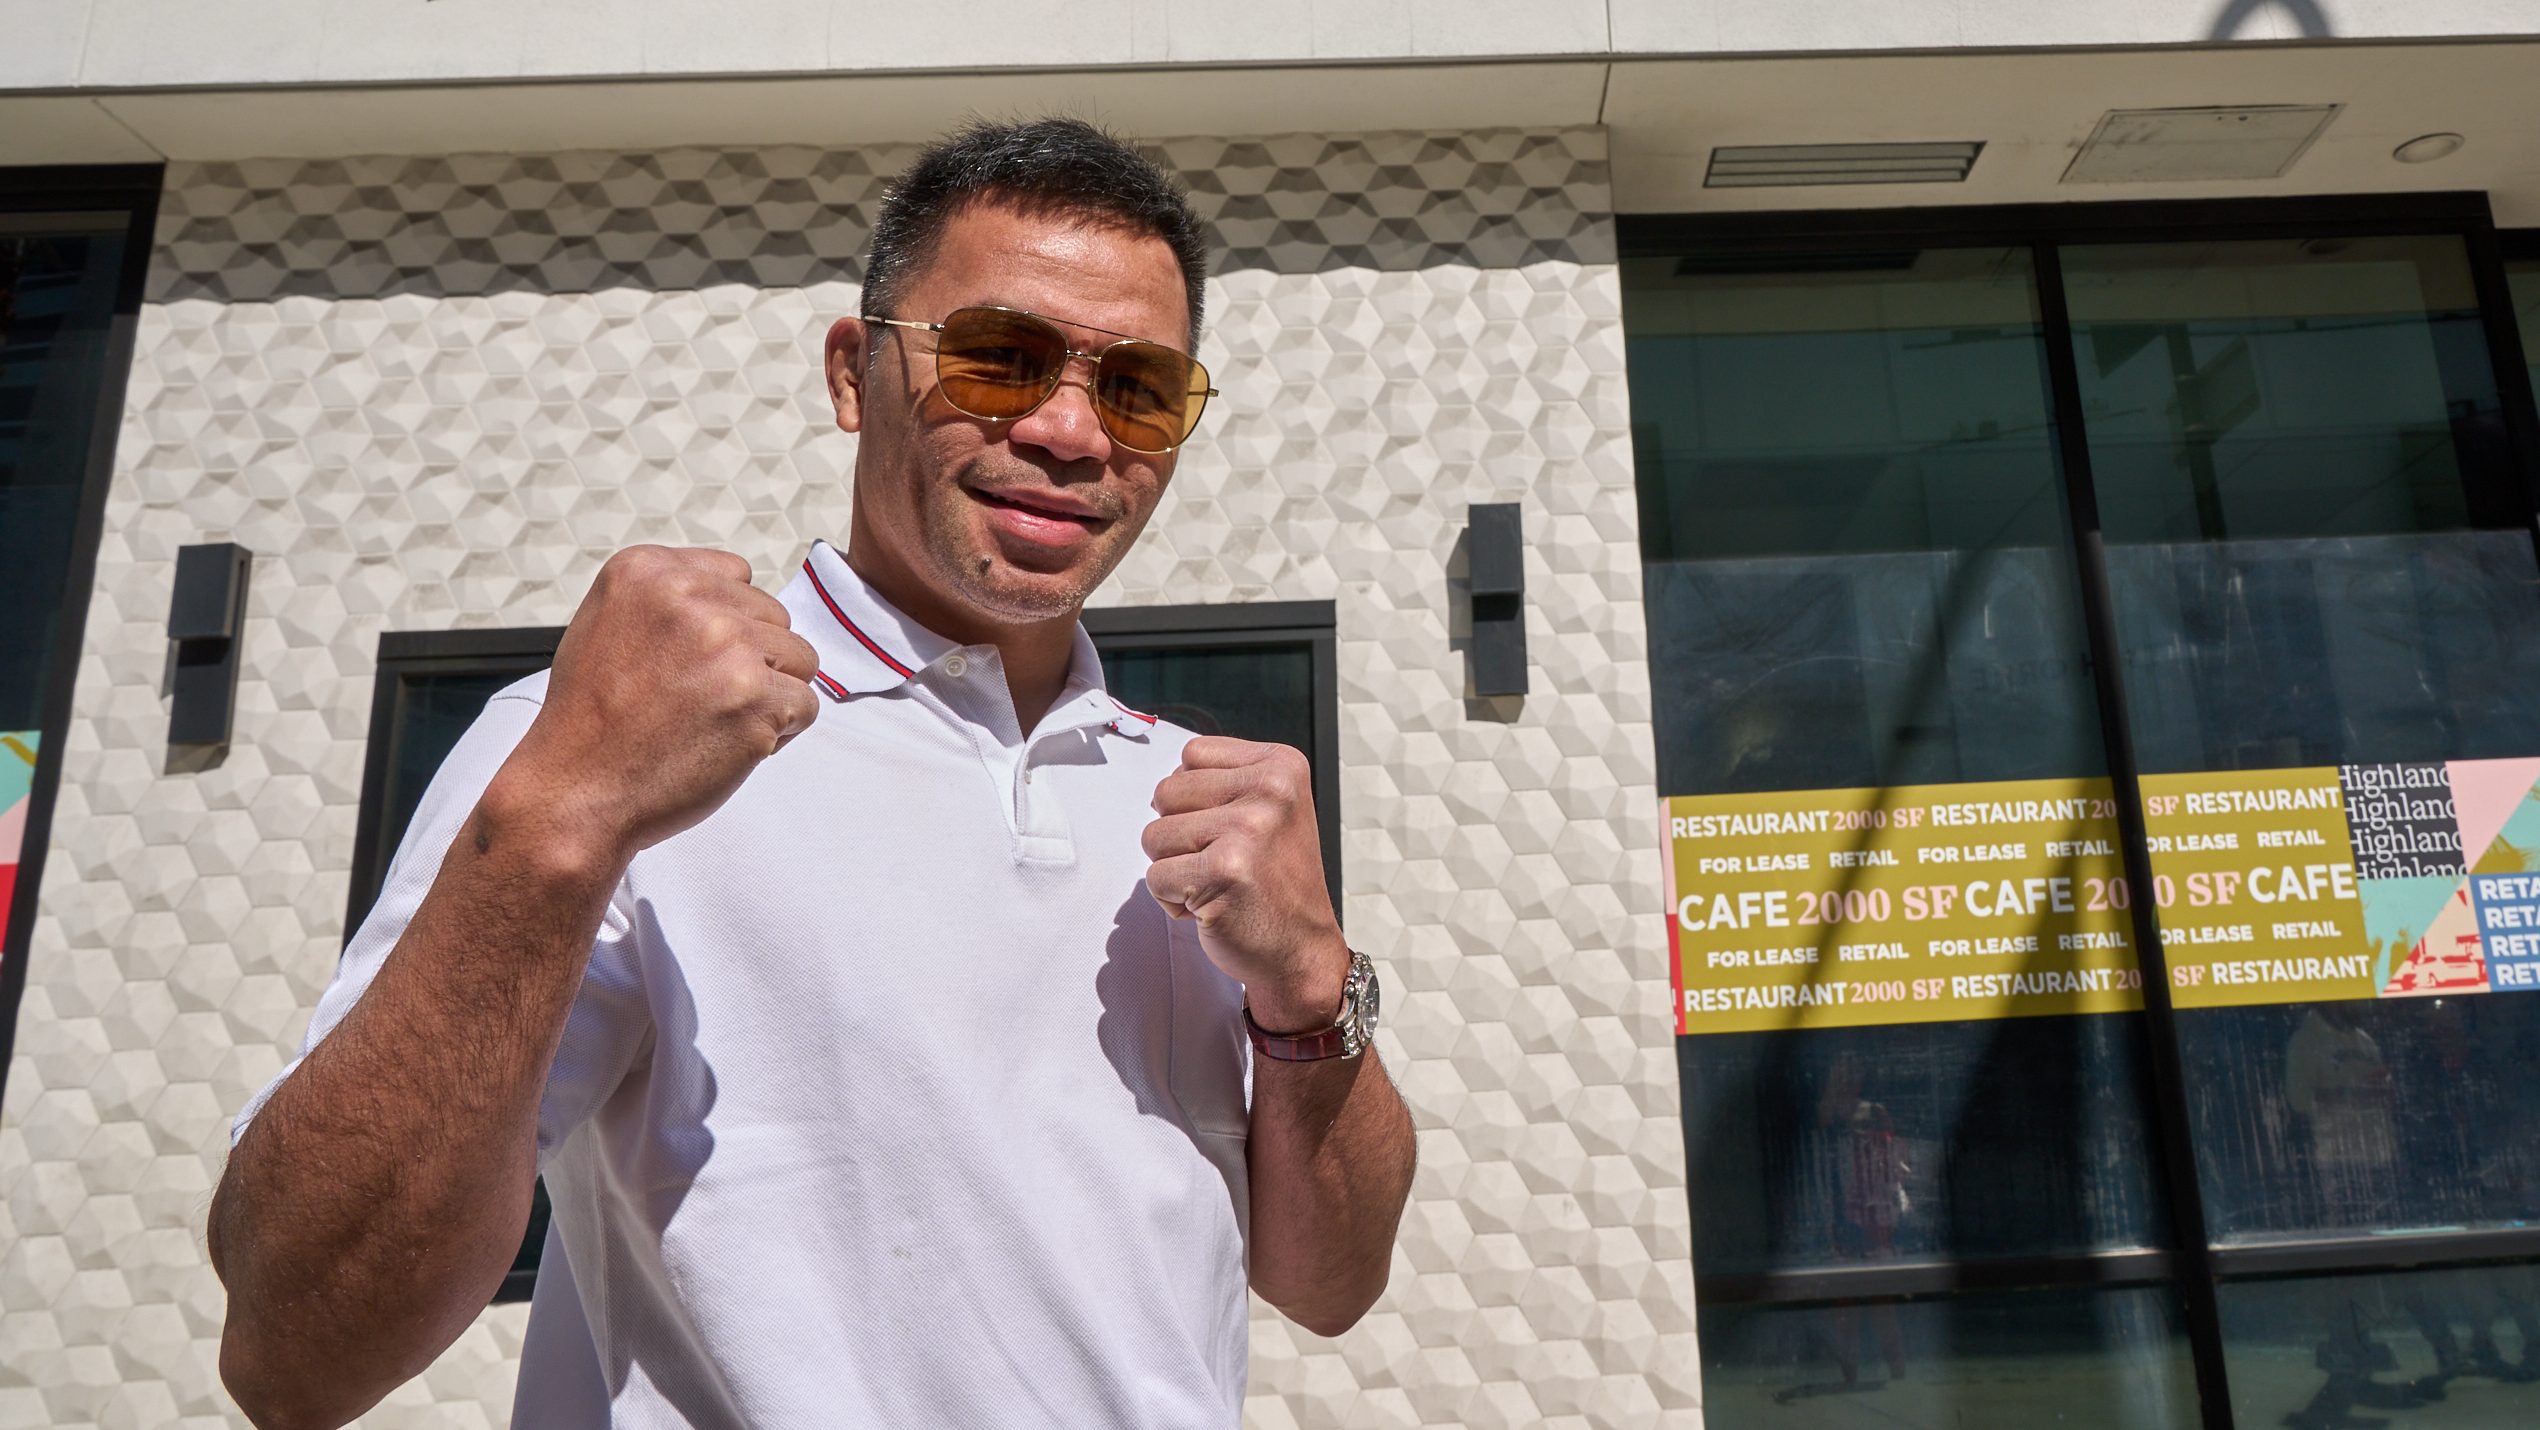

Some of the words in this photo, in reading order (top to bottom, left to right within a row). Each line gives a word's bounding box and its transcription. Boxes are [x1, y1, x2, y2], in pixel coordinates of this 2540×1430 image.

[1671, 810, 1829, 839] RESTAURANT
[1833, 810, 1887, 831] 2000
[1892, 807, 1925, 829] SF
[1930, 798, 2087, 827] RESTAURANT
[2091, 799, 2117, 819] 20
[2147, 795, 2180, 817] SF
[2186, 786, 2340, 815] RESTAURANT
[1699, 856, 1742, 875] FOR
[1745, 853, 1811, 873] LEASE
[1828, 848, 1900, 869] RETAIL
[1917, 846, 1960, 864] FOR
[1962, 842, 2028, 863] LEASE
[2044, 839, 2114, 858] RETAIL
[2146, 836, 2172, 853] OR
[2176, 833, 2239, 851] LEASE
[2256, 829, 2326, 848] RETAIL
[1678, 890, 1790, 931] CAFE
[1796, 887, 1891, 926] 2000
[1902, 884, 1958, 921] SF
[1964, 876, 2075, 918] CAFE
[2186, 871, 2241, 907] SF
[2248, 863, 2357, 903] CAFE
[2484, 905, 2540, 929] RET
[1707, 951, 1749, 968] FOR
[1753, 946, 1819, 967] LEASE
[1838, 942, 1910, 962] RETAIL
[1928, 939, 1971, 958] FOR
[1974, 935, 2039, 956] LEASE
[2058, 931, 2128, 951] RETAIL
[2160, 928, 2186, 946] OR
[2189, 924, 2254, 945] LEASE
[2271, 920, 2342, 940] RETAIL
[1685, 982, 1847, 1012] RESTAURANT
[1851, 980, 1906, 1003] 2000
[1911, 978, 1945, 1001] SF
[1952, 968, 2112, 998] RESTAURANT
[2115, 969, 2142, 990] 20
[2173, 965, 2206, 987] SF
[2210, 954, 2370, 985] RESTAURANT
